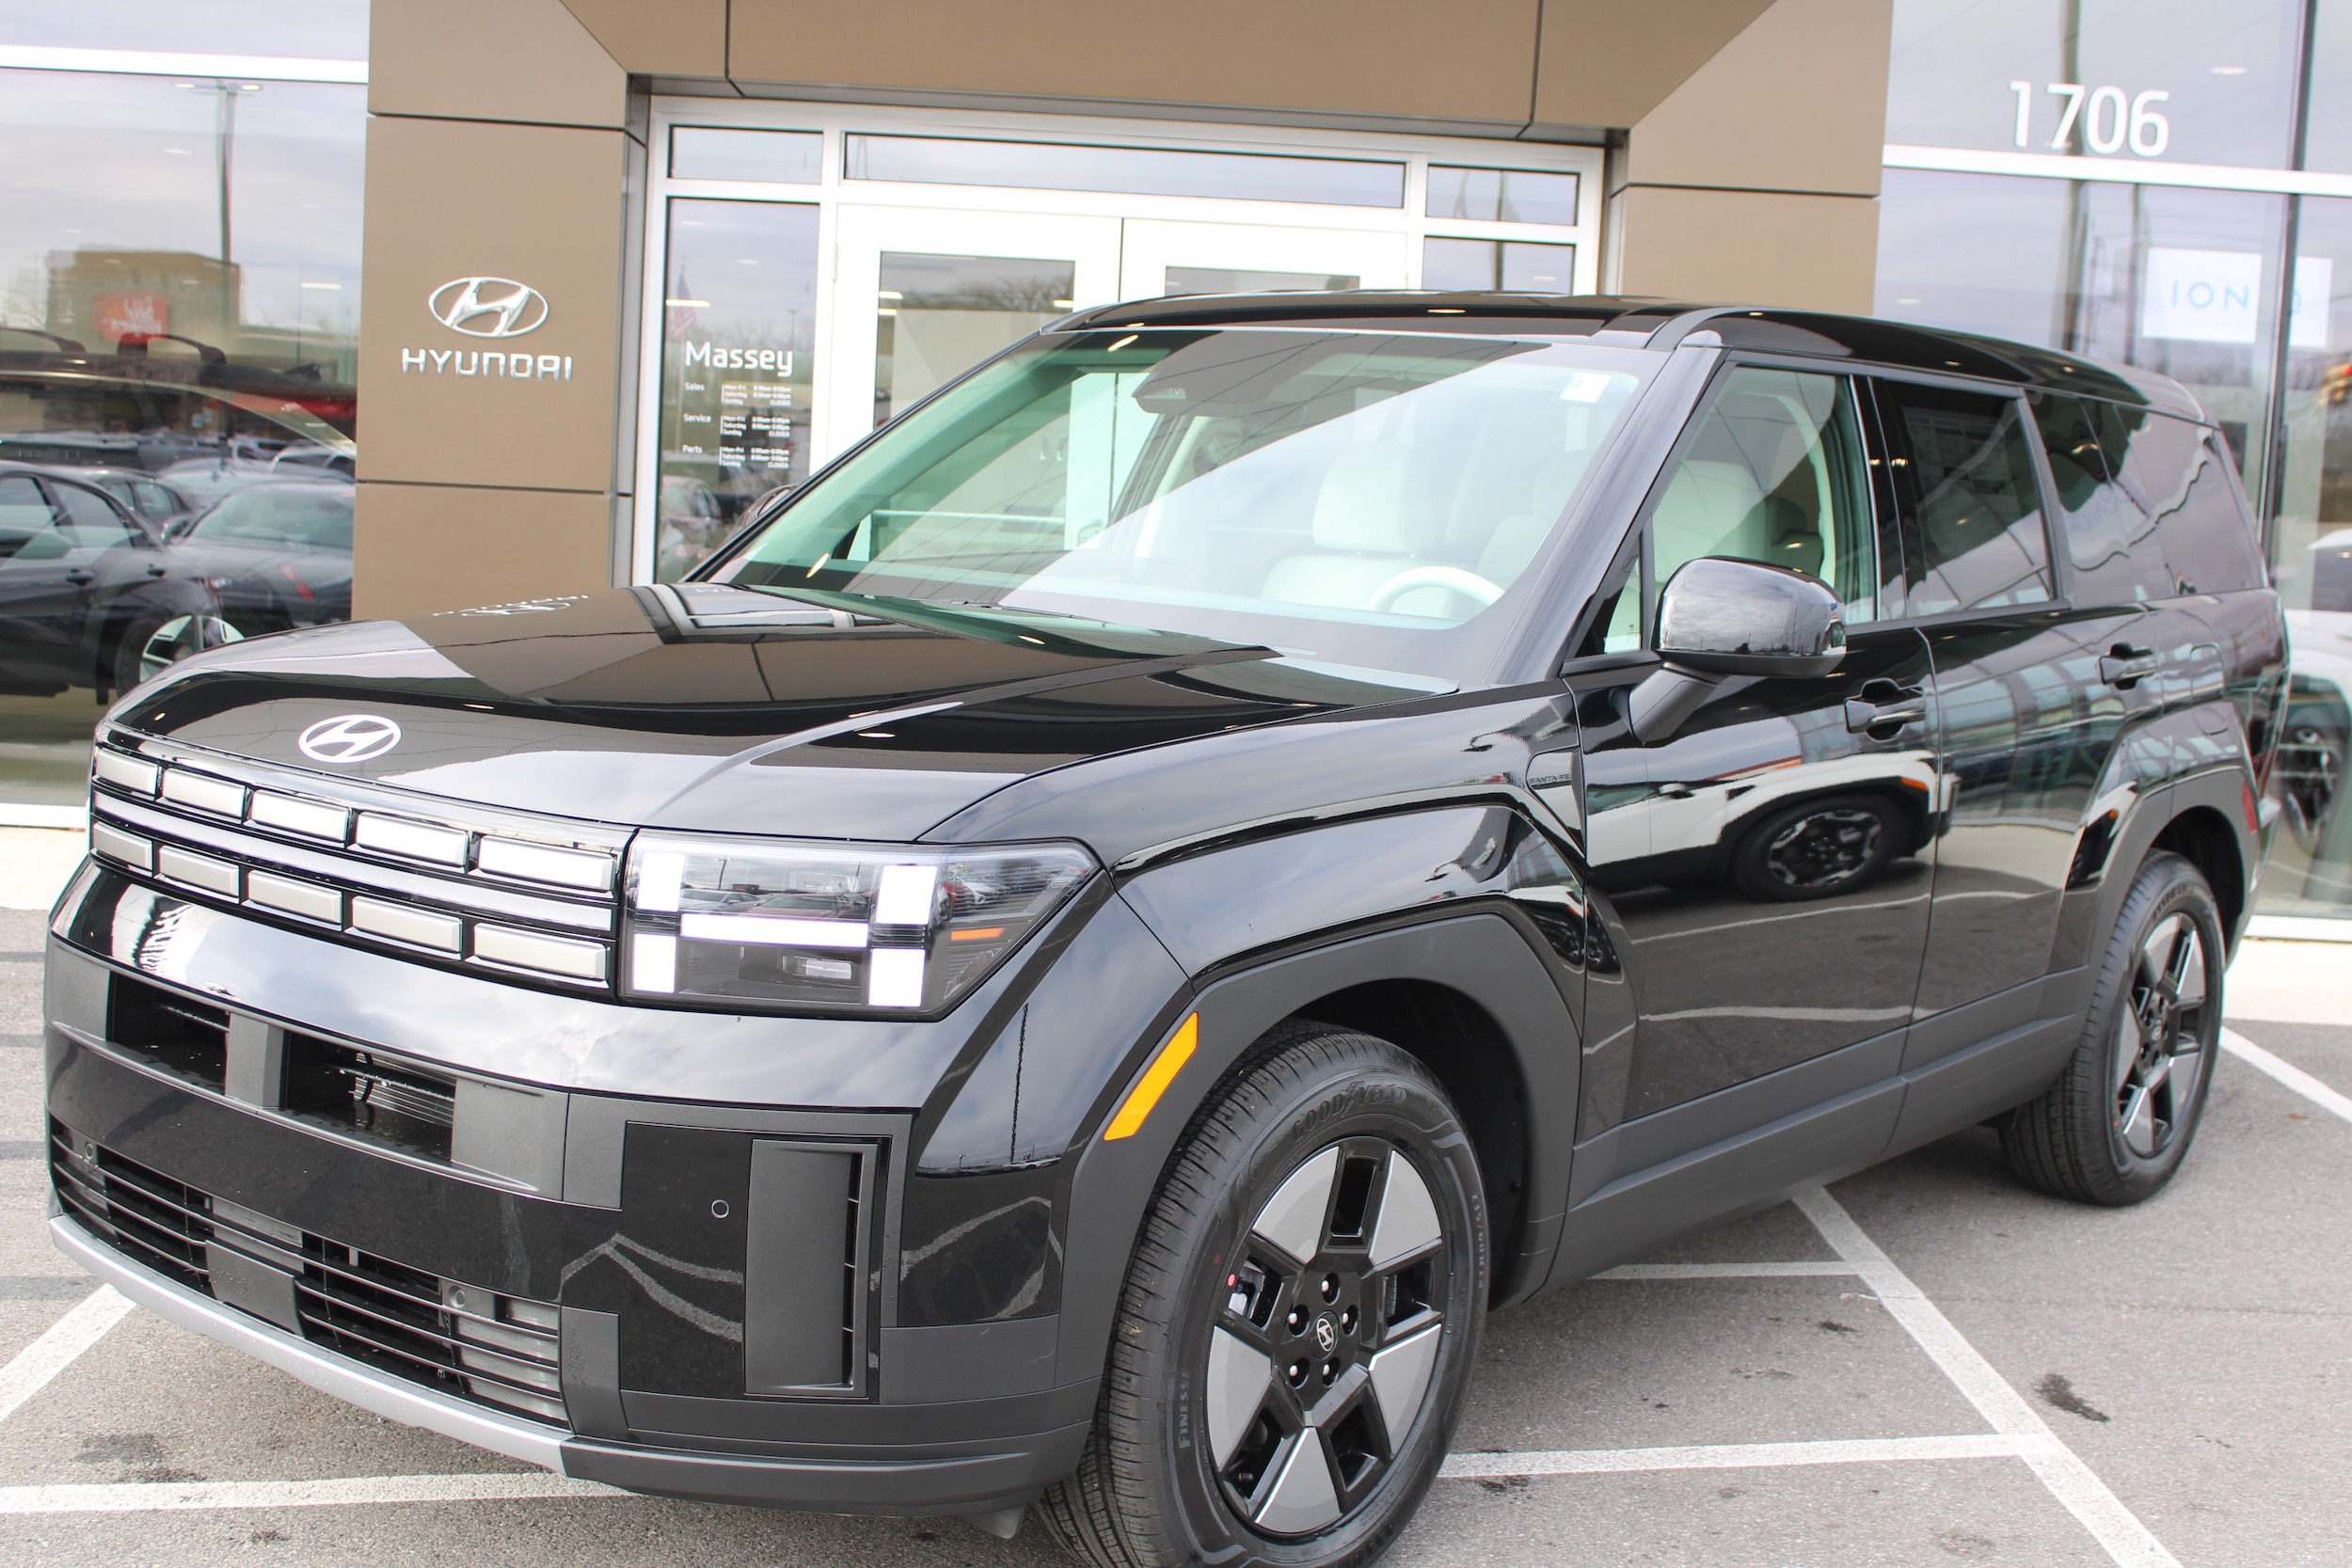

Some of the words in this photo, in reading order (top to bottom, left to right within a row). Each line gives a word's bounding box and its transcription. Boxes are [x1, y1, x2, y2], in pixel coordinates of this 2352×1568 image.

[2009, 80, 2169, 158] 1706
[2171, 280, 2302, 314] ION
[402, 348, 573, 381] HYUNDAI
[685, 341, 793, 378] Massey
[685, 382, 706, 391] Sales
[683, 413, 712, 423] Service
[682, 444, 703, 453] Parts
[1529, 775, 1558, 784] SANTA
[1291, 1080, 1407, 1142] GOODYEAR
[1178, 1367, 1191, 1449] FINESSE
